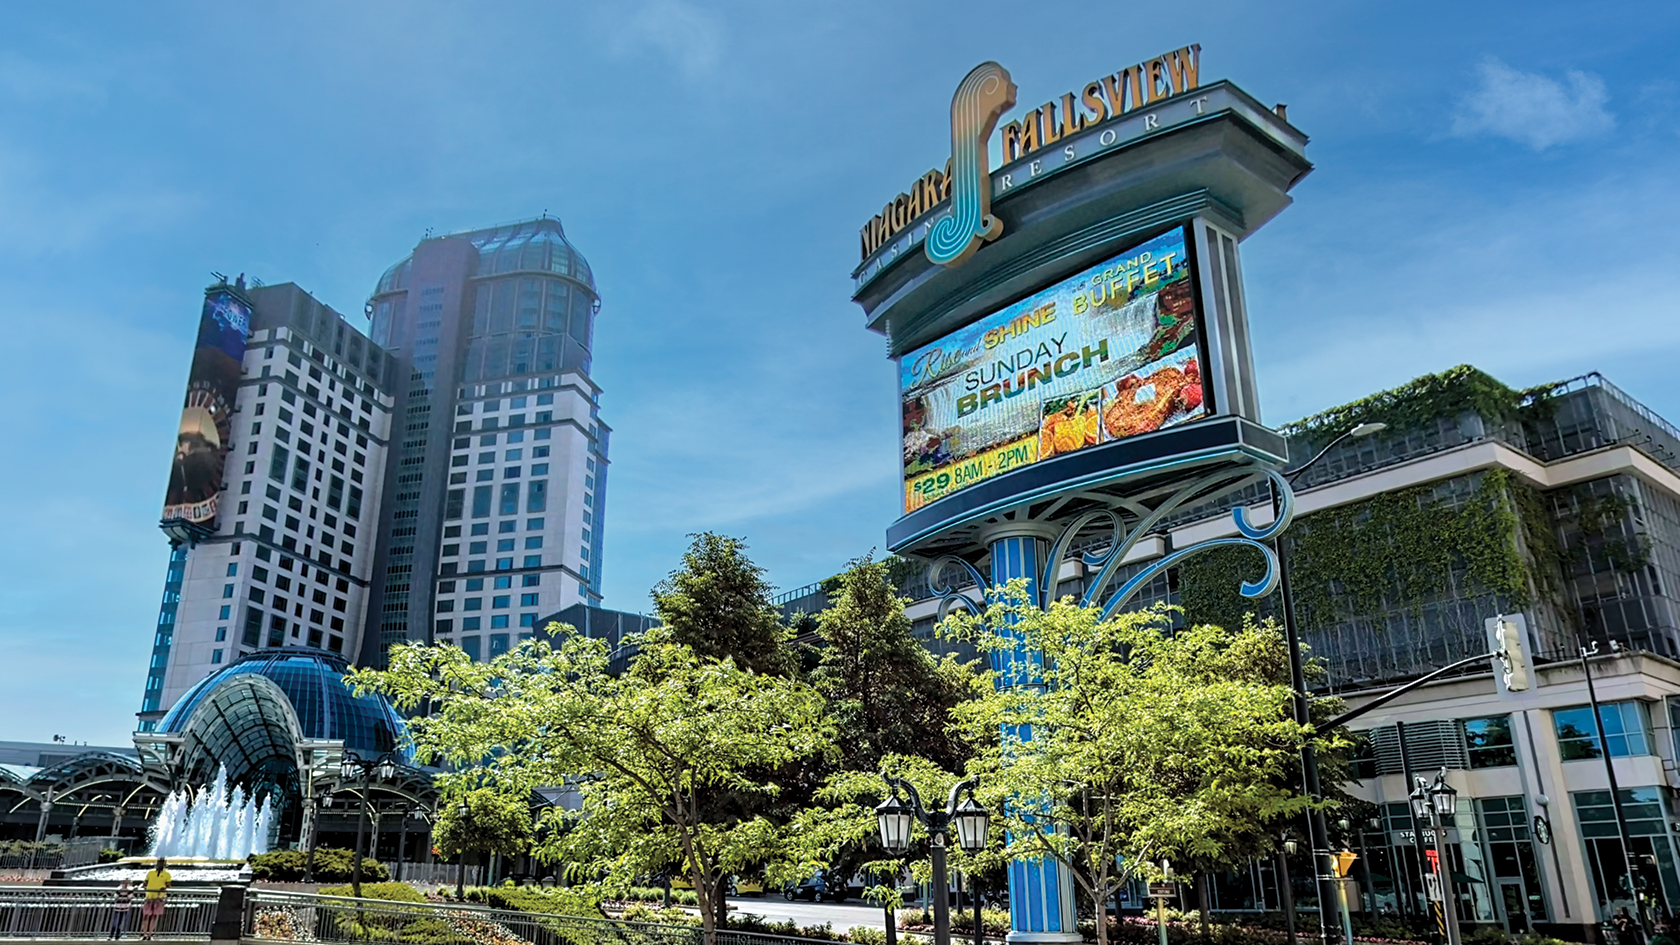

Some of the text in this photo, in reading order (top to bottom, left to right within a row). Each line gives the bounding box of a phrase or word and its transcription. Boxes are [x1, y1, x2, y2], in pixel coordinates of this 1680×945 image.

[860, 42, 1202, 263] NIAGARA FALLSVIEW
[859, 96, 1208, 285] CASIN RESORT
[1073, 252, 1177, 316] BUFFET
[1091, 251, 1153, 287] GRAND
[911, 348, 962, 390] Rise
[984, 302, 1057, 350] SHINE
[957, 338, 1110, 419] BRUNCH
[965, 331, 1068, 391] SUNDAY
[914, 472, 952, 495] $29
[954, 460, 983, 484] 8AM
[997, 445, 1028, 470] 2PM
